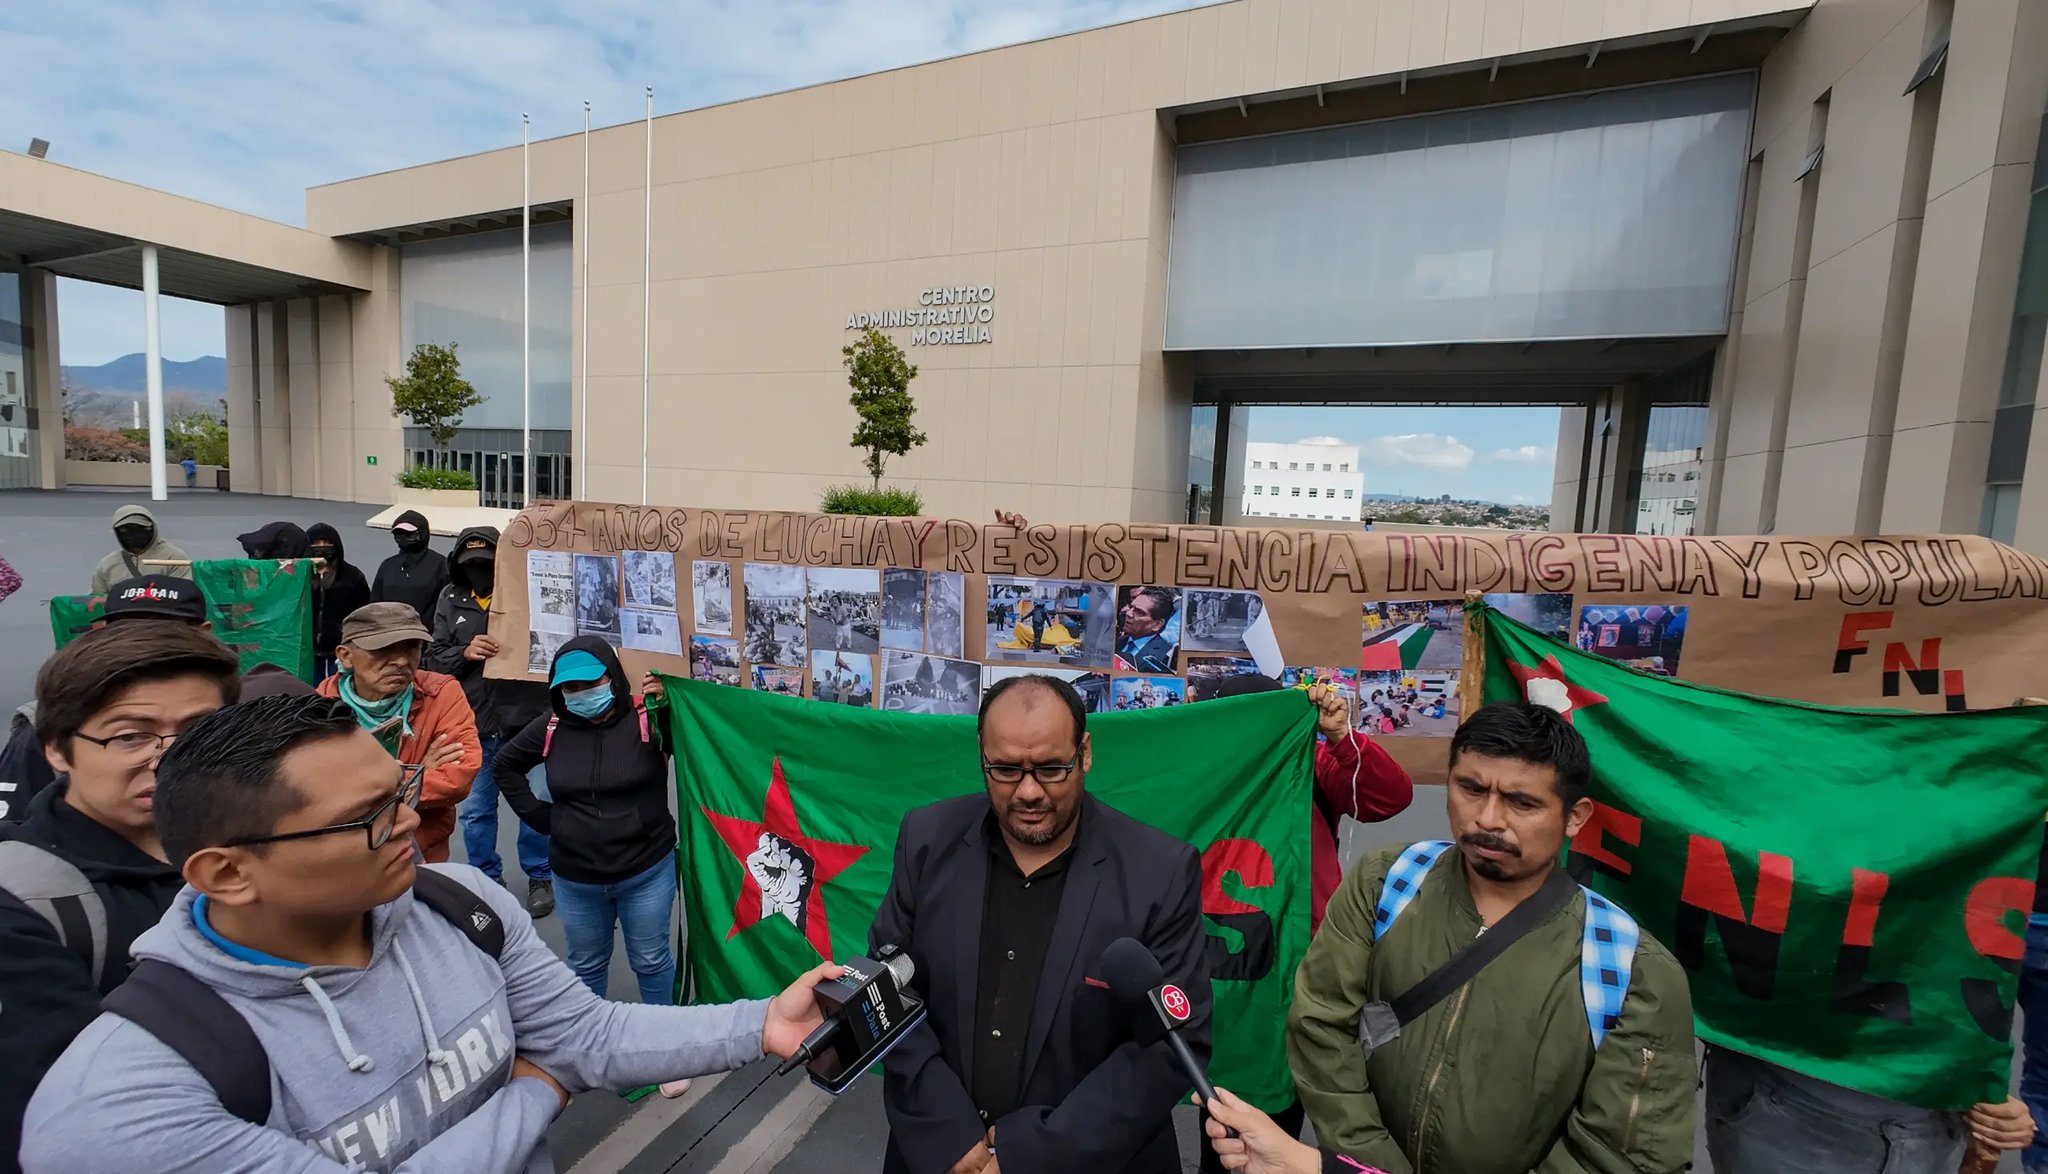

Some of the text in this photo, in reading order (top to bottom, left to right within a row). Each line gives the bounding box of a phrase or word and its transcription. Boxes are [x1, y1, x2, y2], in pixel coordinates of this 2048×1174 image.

[919, 284, 994, 306] CENTRO
[845, 305, 993, 329] ADMINISTRATIVO
[911, 326, 992, 347] MORELIA
[592, 504, 688, 552] AÑOS
[700, 510, 748, 558] DE
[754, 515, 897, 567] LUCHA
[901, 519, 938, 568] Y
[946, 519, 1369, 593] RESISTENCIA
[1711, 540, 1770, 599] Y
[120, 587, 178, 600] JORDAN
[850, 969, 869, 982] Post
[866, 1012, 880, 1040] Data
[876, 1004, 891, 1031] Post
[416, 1008, 512, 1117] YORK
